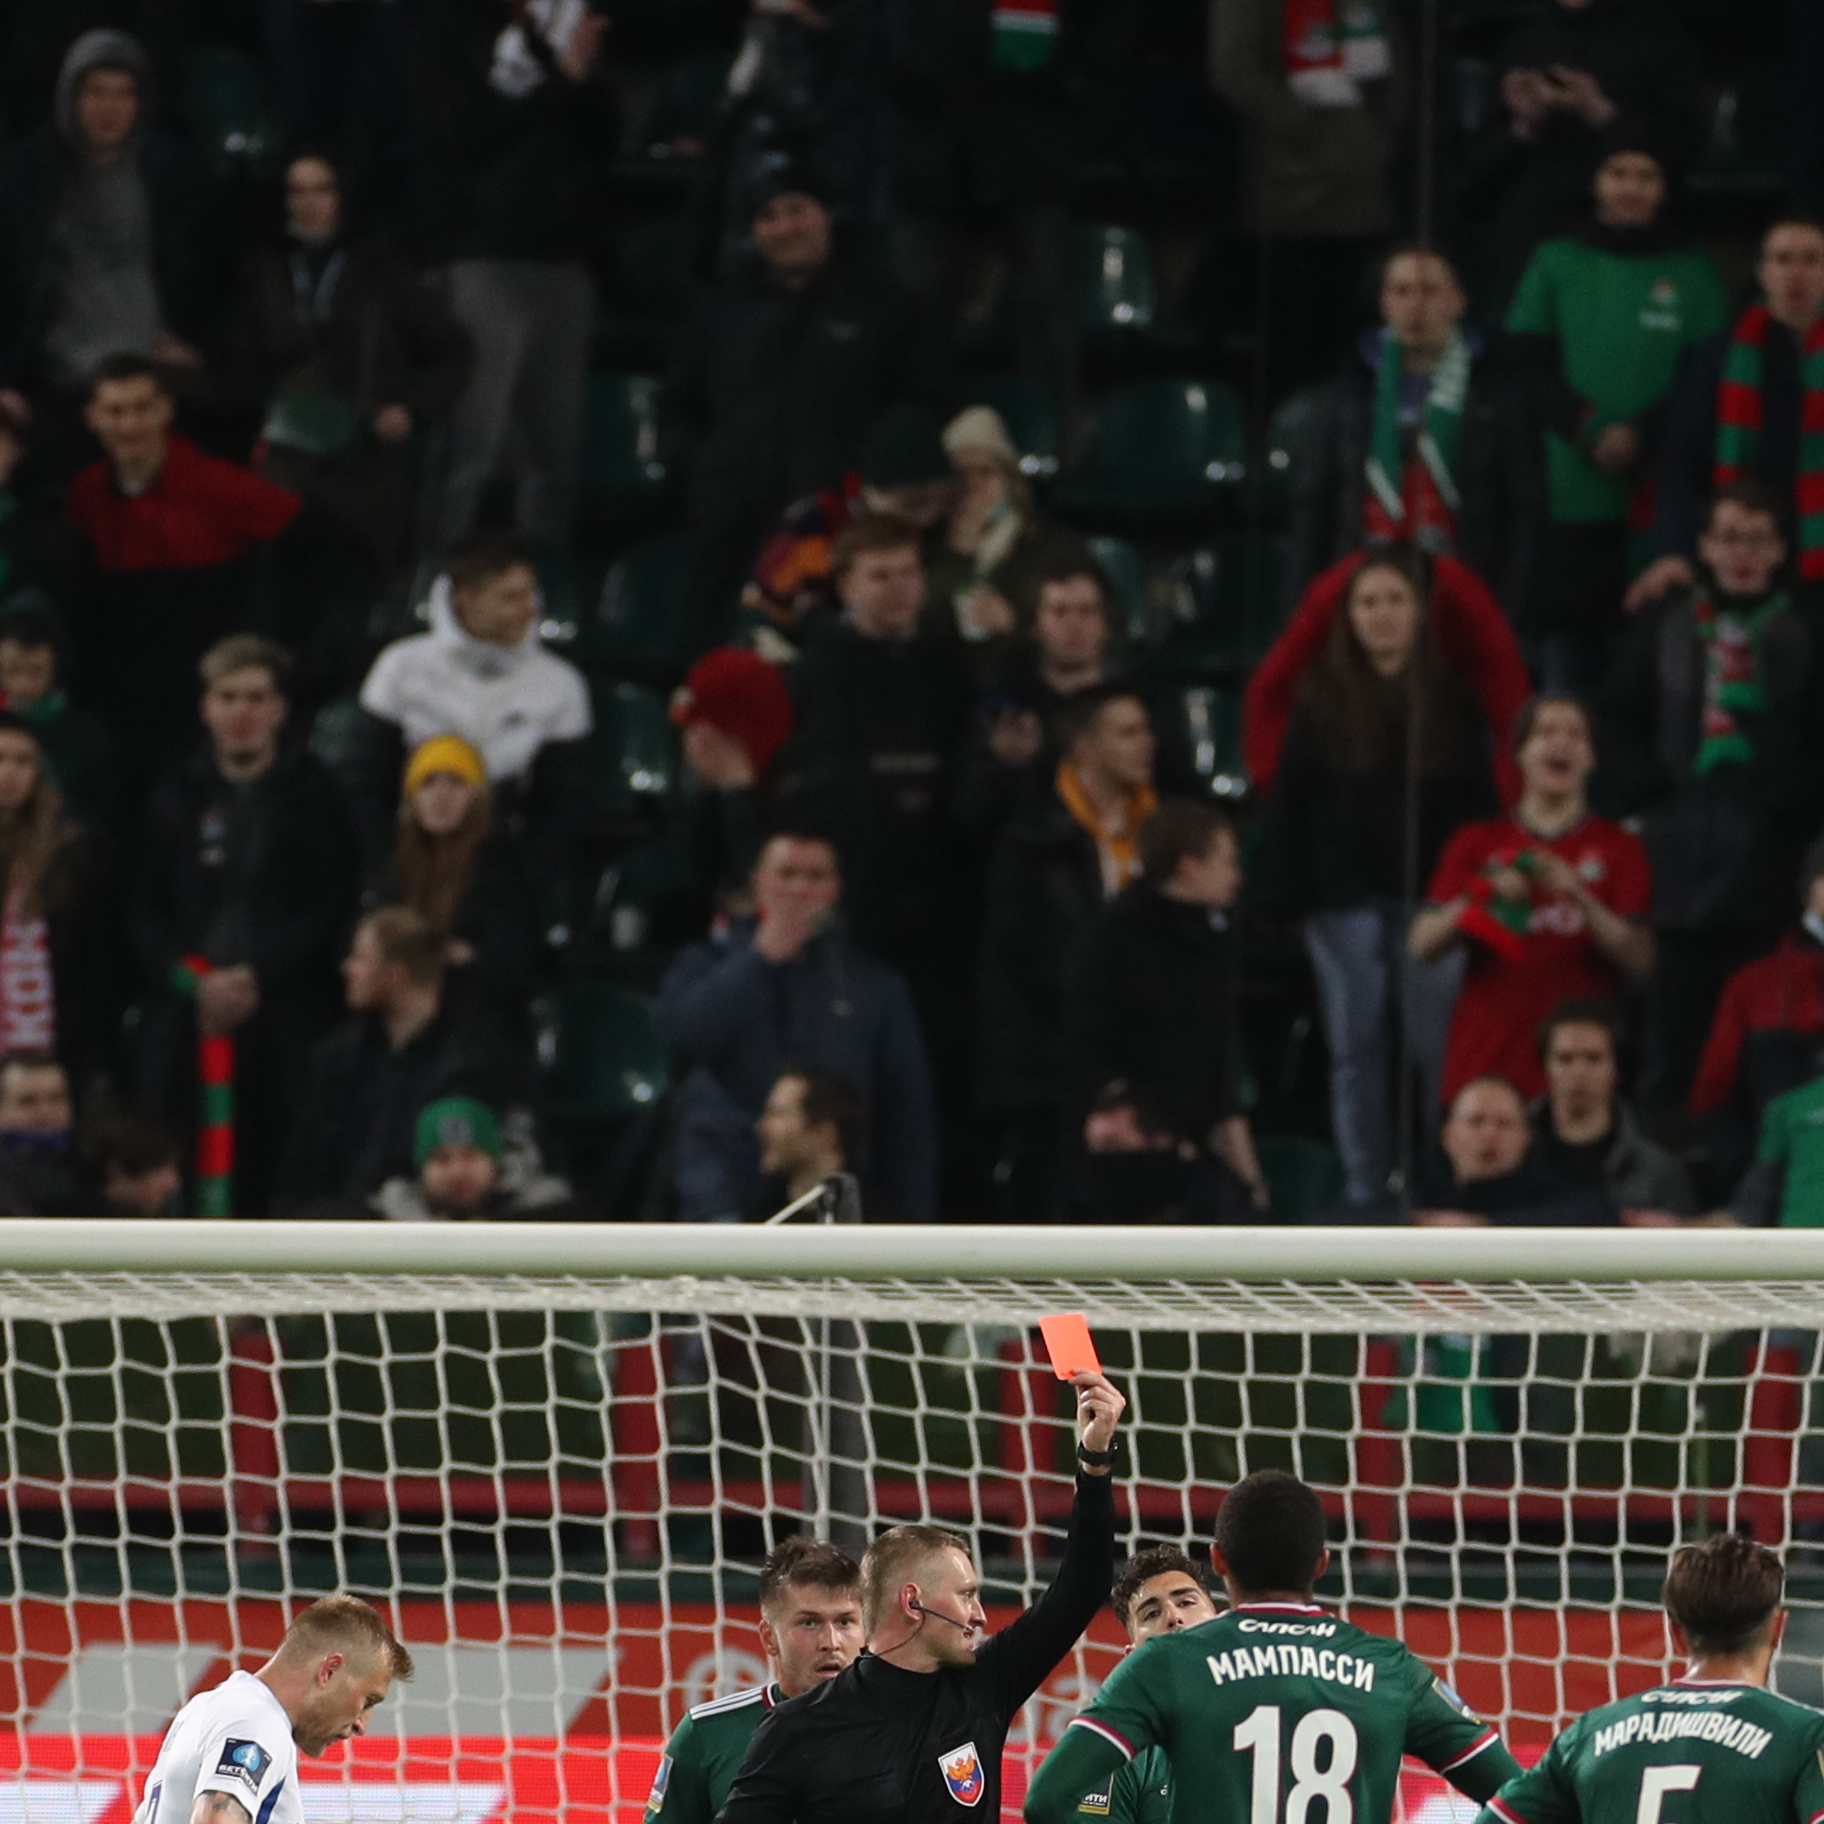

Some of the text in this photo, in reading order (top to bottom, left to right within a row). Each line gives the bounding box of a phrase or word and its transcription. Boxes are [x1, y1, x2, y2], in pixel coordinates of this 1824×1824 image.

[1238, 1618, 1336, 1637] САПСАН
[1206, 1645, 1374, 1692] МАМПАССИ
[1594, 1711, 1775, 1759] МАРАДИШВИЛИ
